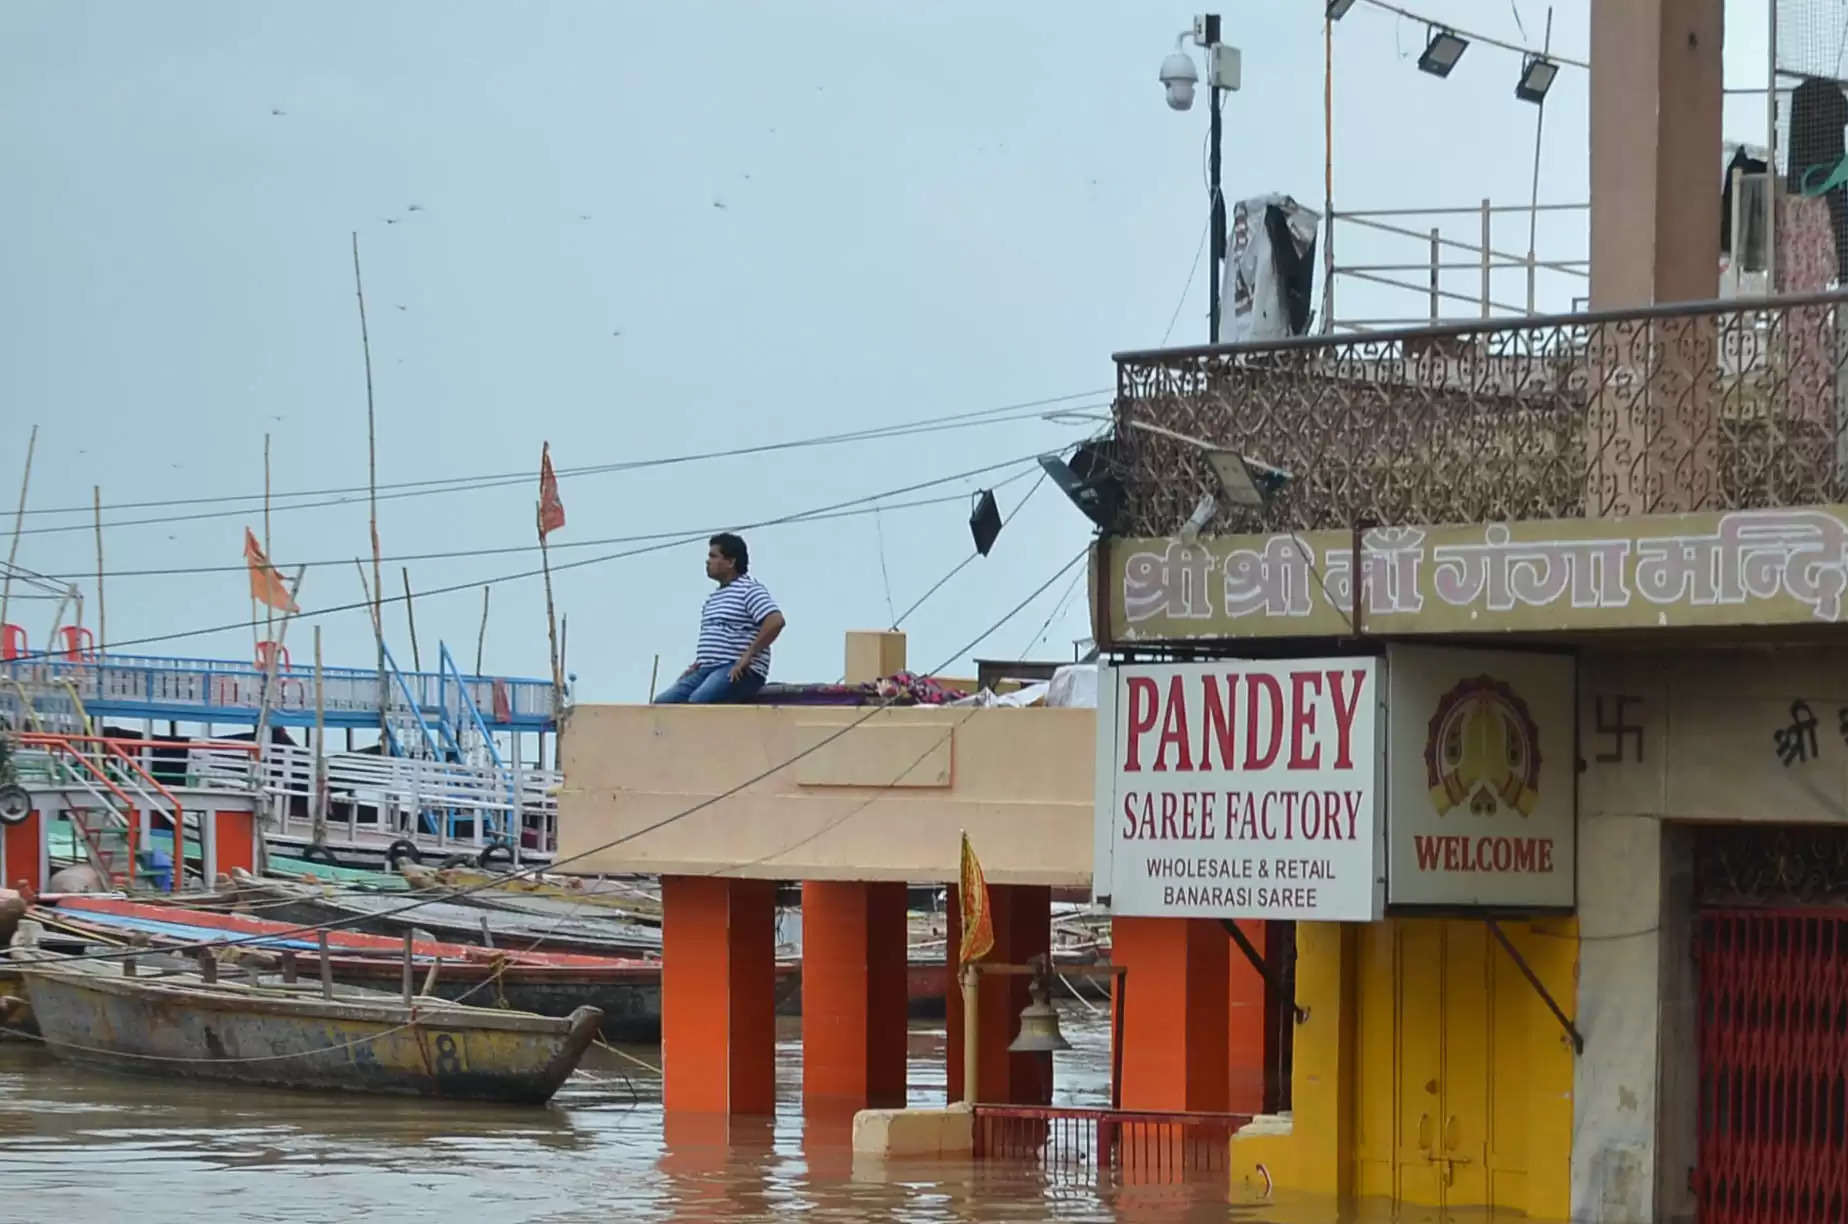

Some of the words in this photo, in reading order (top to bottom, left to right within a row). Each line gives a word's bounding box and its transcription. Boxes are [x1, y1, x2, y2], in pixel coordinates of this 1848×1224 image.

[1124, 541, 1213, 622] श्री
[1224, 533, 1314, 618] श्री
[1433, 524, 1632, 611] गंगा
[1123, 669, 1367, 773] PANDEY
[1773, 698, 1819, 769] श्री
[1122, 791, 1215, 841] SAREE
[1225, 790, 1364, 841] FACTORY
[1146, 858, 1254, 880] WHOLESALE
[1257, 858, 1270, 880] &
[1274, 858, 1337, 881] RETAIL
[1413, 835, 1554, 874] WELCOME
[1163, 886, 1254, 908] BANARASI
[1257, 887, 1318, 909] SAREE
